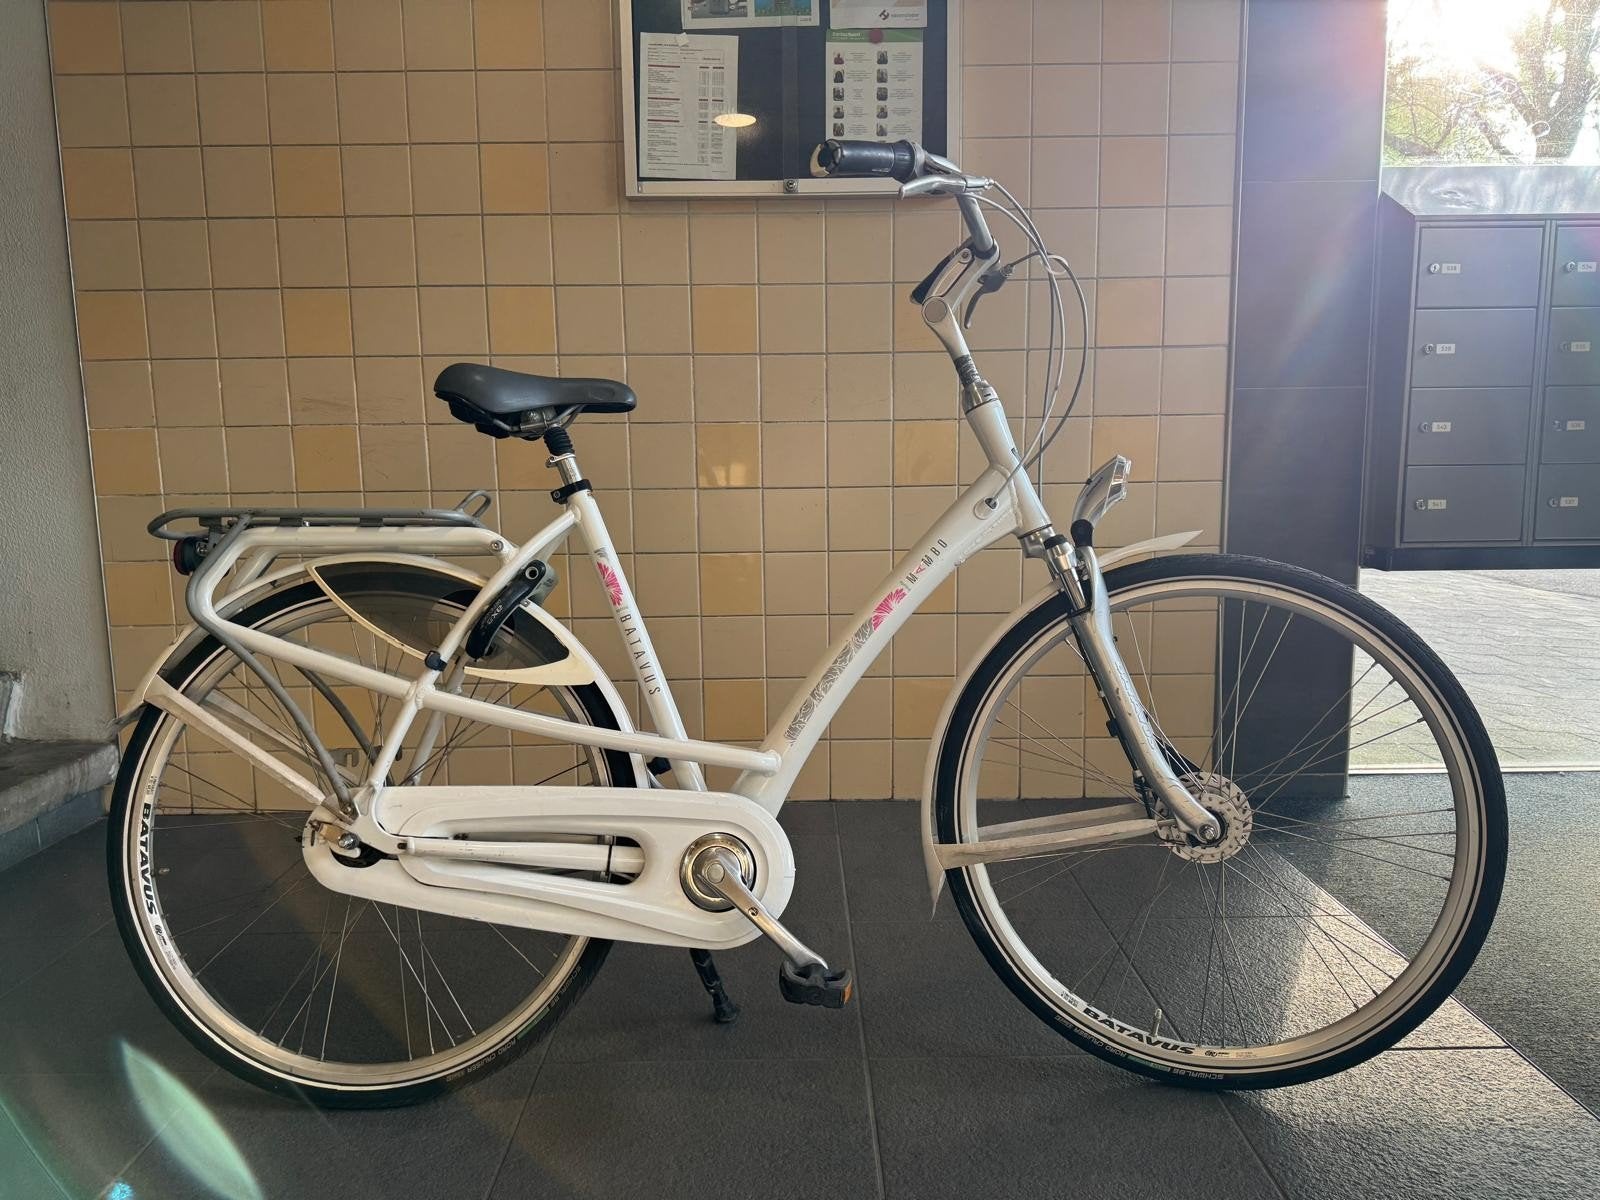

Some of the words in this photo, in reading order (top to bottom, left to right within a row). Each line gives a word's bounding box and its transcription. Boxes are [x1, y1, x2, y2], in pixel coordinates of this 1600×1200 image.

[905, 538, 948, 584] MAMBO
[620, 613, 661, 696] BATAVUS
[139, 802, 158, 916] BATAVUS
[1073, 1026, 1104, 1048] CRUISER
[1083, 1007, 1196, 1055] BATAVUS
[1171, 1068, 1224, 1080] SCHWALBE
